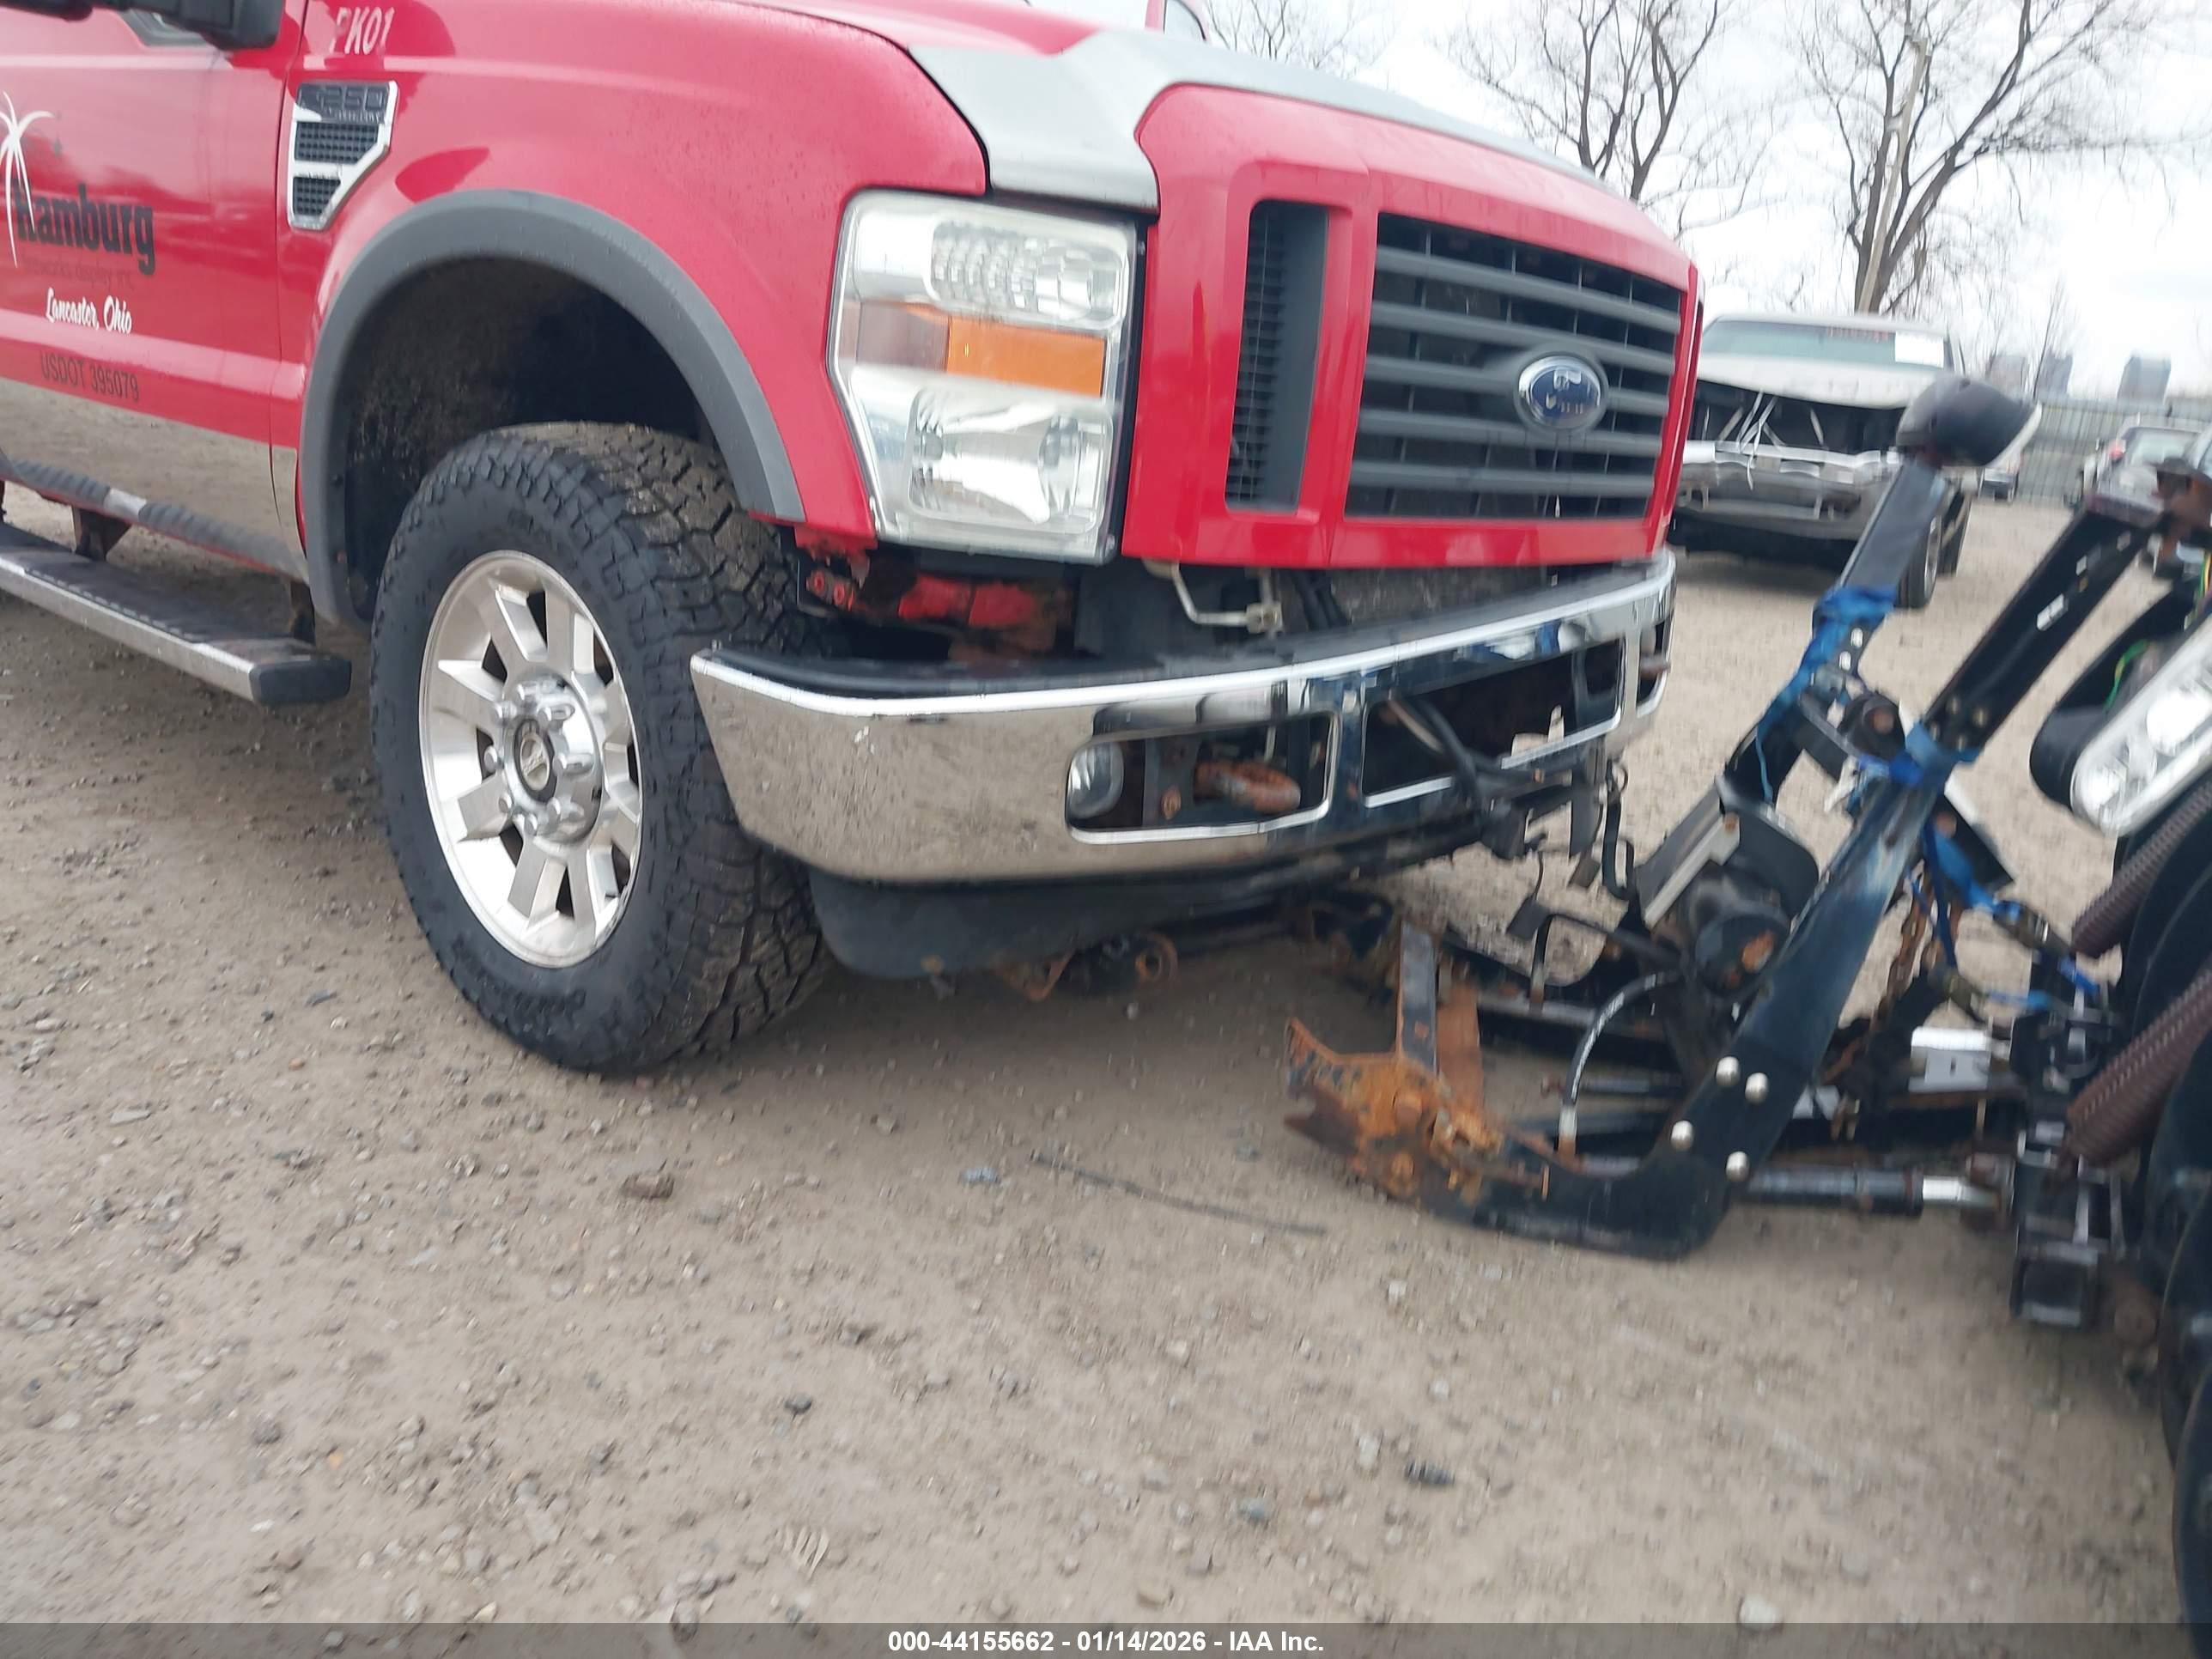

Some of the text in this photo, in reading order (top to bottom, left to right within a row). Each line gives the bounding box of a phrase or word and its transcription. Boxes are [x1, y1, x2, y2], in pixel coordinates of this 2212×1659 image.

[13, 178, 156, 276] Hamburg
[103, 295, 133, 335] Ohio
[40, 350, 86, 388] USDOT
